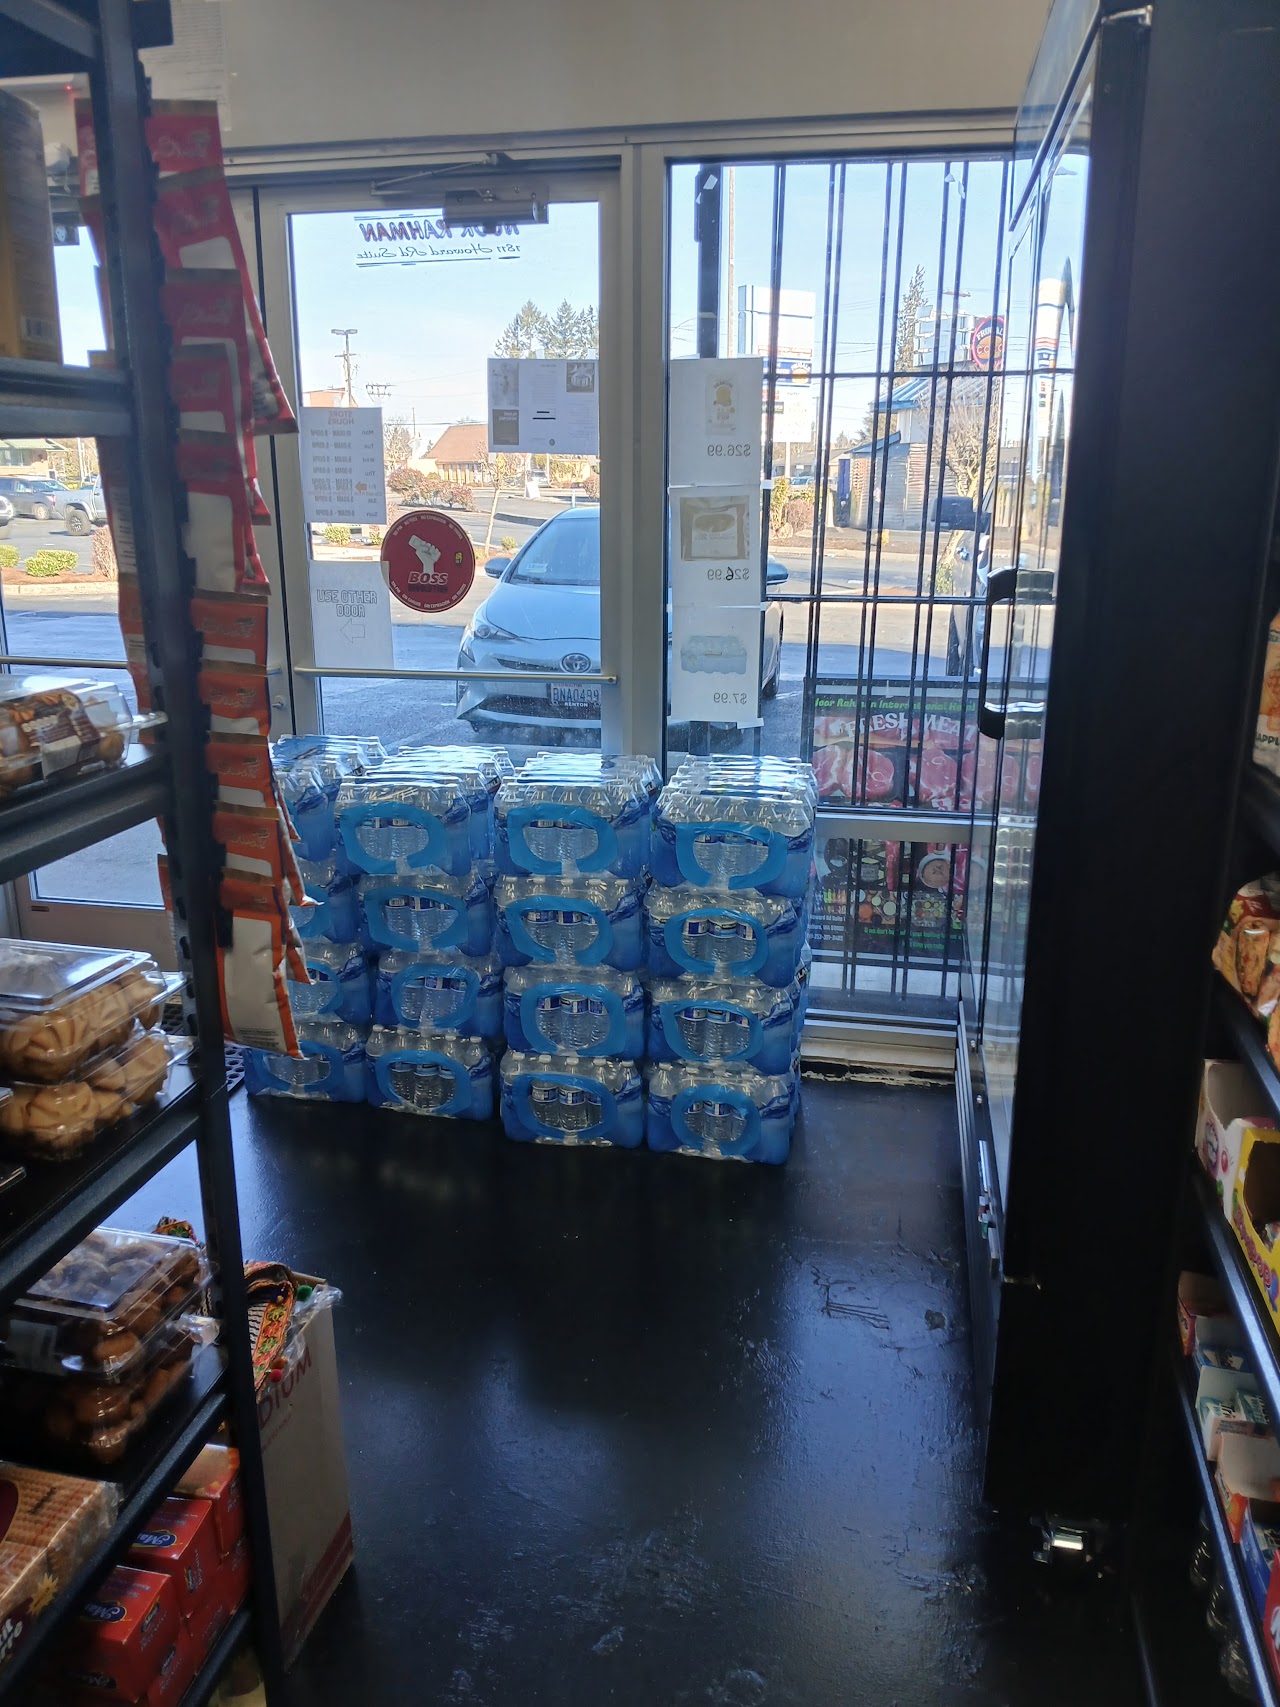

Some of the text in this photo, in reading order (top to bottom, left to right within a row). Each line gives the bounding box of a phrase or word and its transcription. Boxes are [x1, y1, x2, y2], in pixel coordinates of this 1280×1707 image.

[408, 571, 448, 585] BOSS
[316, 589, 378, 604] USE OTHER
[336, 604, 366, 617] DOOR
[836, 698, 877, 708] Rahn
